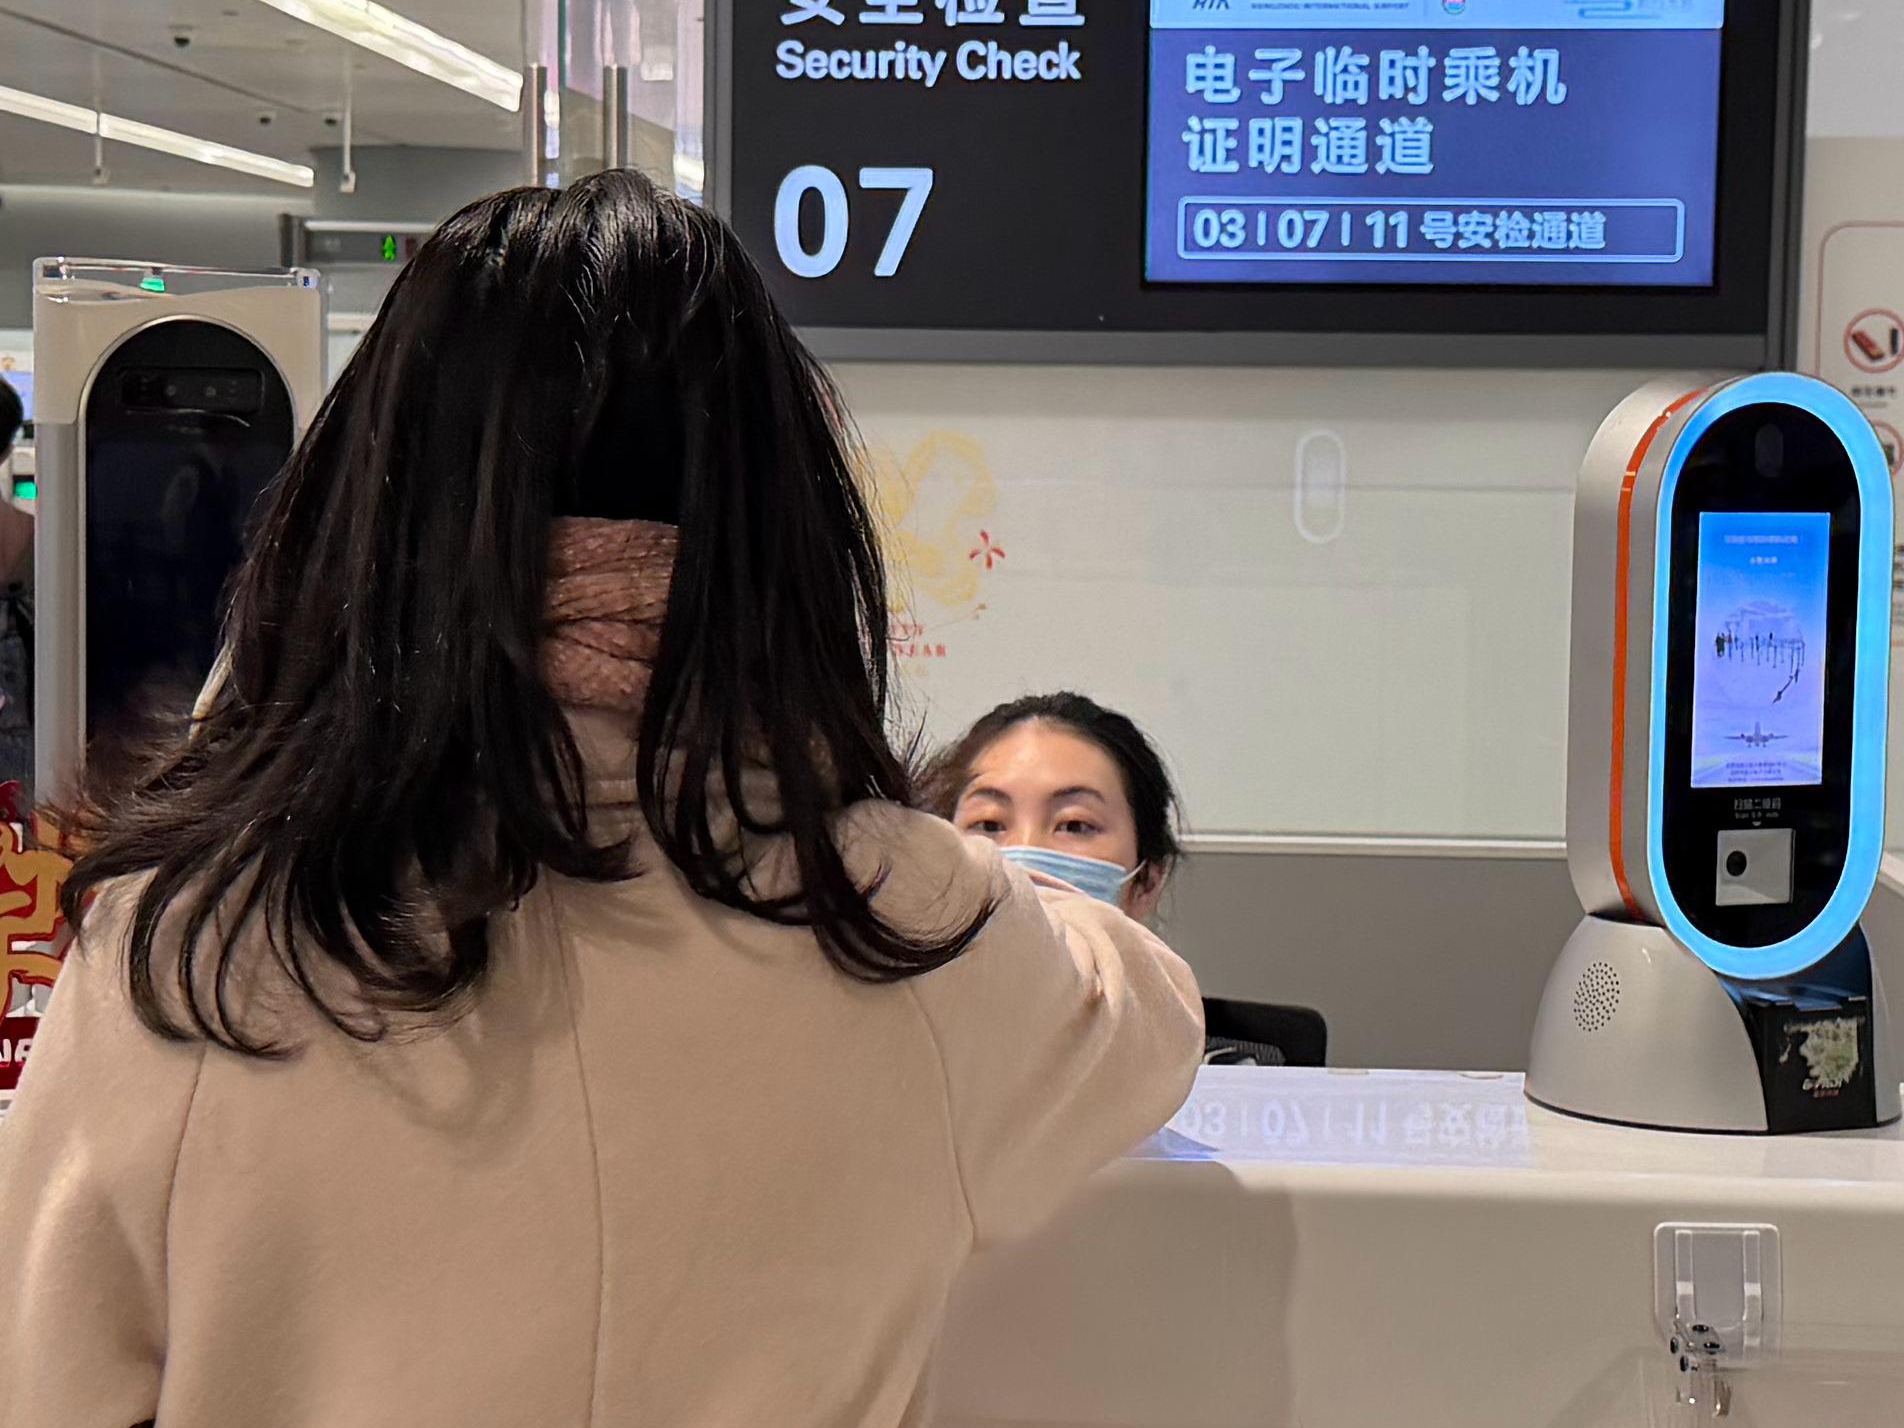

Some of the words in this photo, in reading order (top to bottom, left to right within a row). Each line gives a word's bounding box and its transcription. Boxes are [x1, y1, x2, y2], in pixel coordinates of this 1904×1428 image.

[775, 40, 947, 88] Security
[956, 40, 1083, 83] Check
[1184, 45, 1569, 108] 电子临时乘机
[1181, 115, 1435, 177] 证明通道
[773, 164, 934, 278] 07
